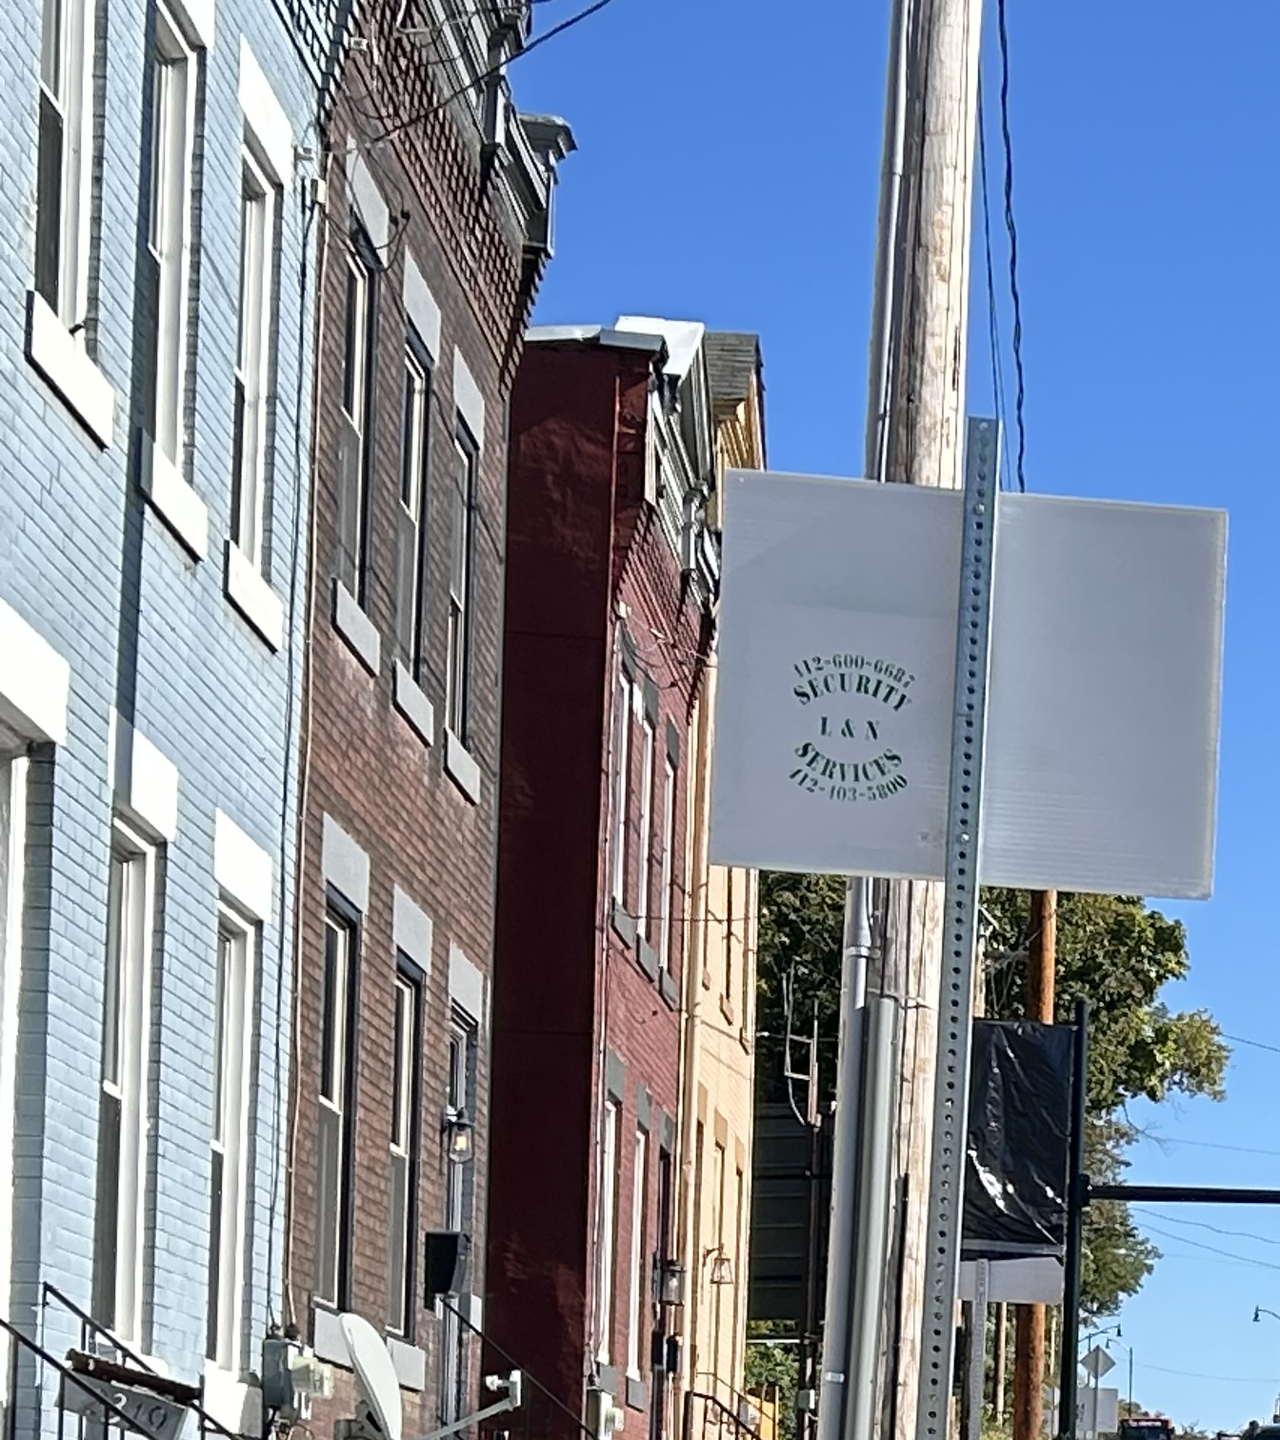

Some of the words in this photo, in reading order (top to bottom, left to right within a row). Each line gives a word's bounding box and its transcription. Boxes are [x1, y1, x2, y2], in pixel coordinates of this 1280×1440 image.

[793, 672, 912, 712] SECURITY
[840, 718, 855, 738] &
[794, 742, 903, 783] SERVICES
